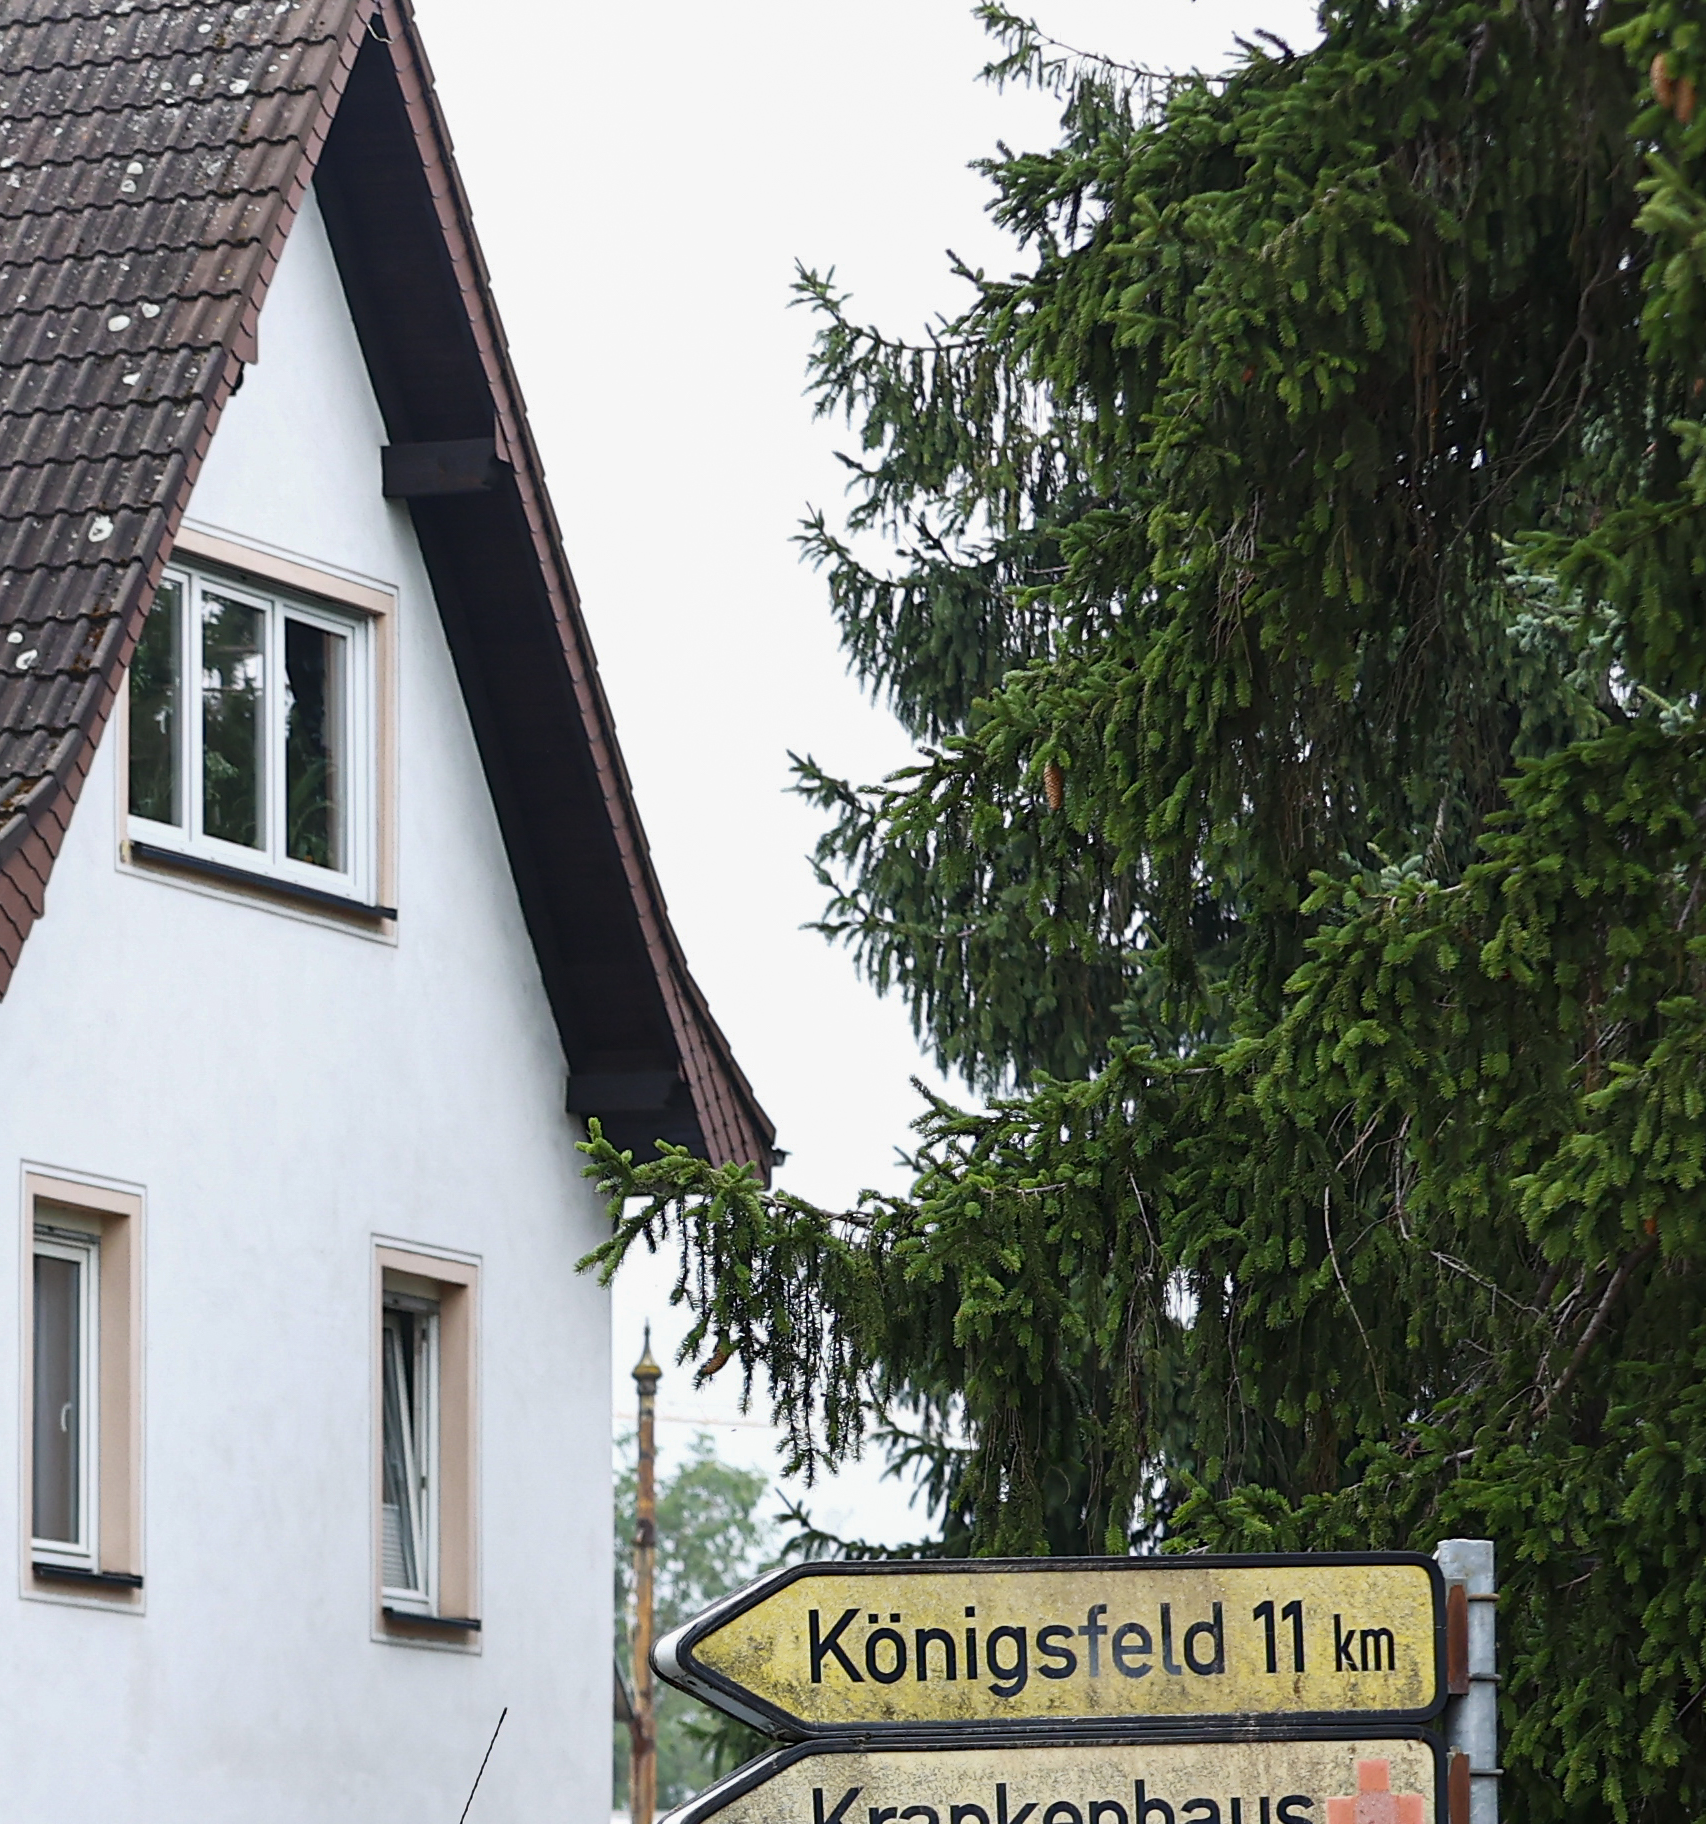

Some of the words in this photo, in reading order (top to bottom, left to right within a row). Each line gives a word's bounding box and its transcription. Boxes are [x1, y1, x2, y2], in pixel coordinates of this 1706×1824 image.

[808, 1602, 1226, 1698] Königsfeld
[1253, 1600, 1305, 1674] 11
[1333, 1613, 1395, 1673] km
